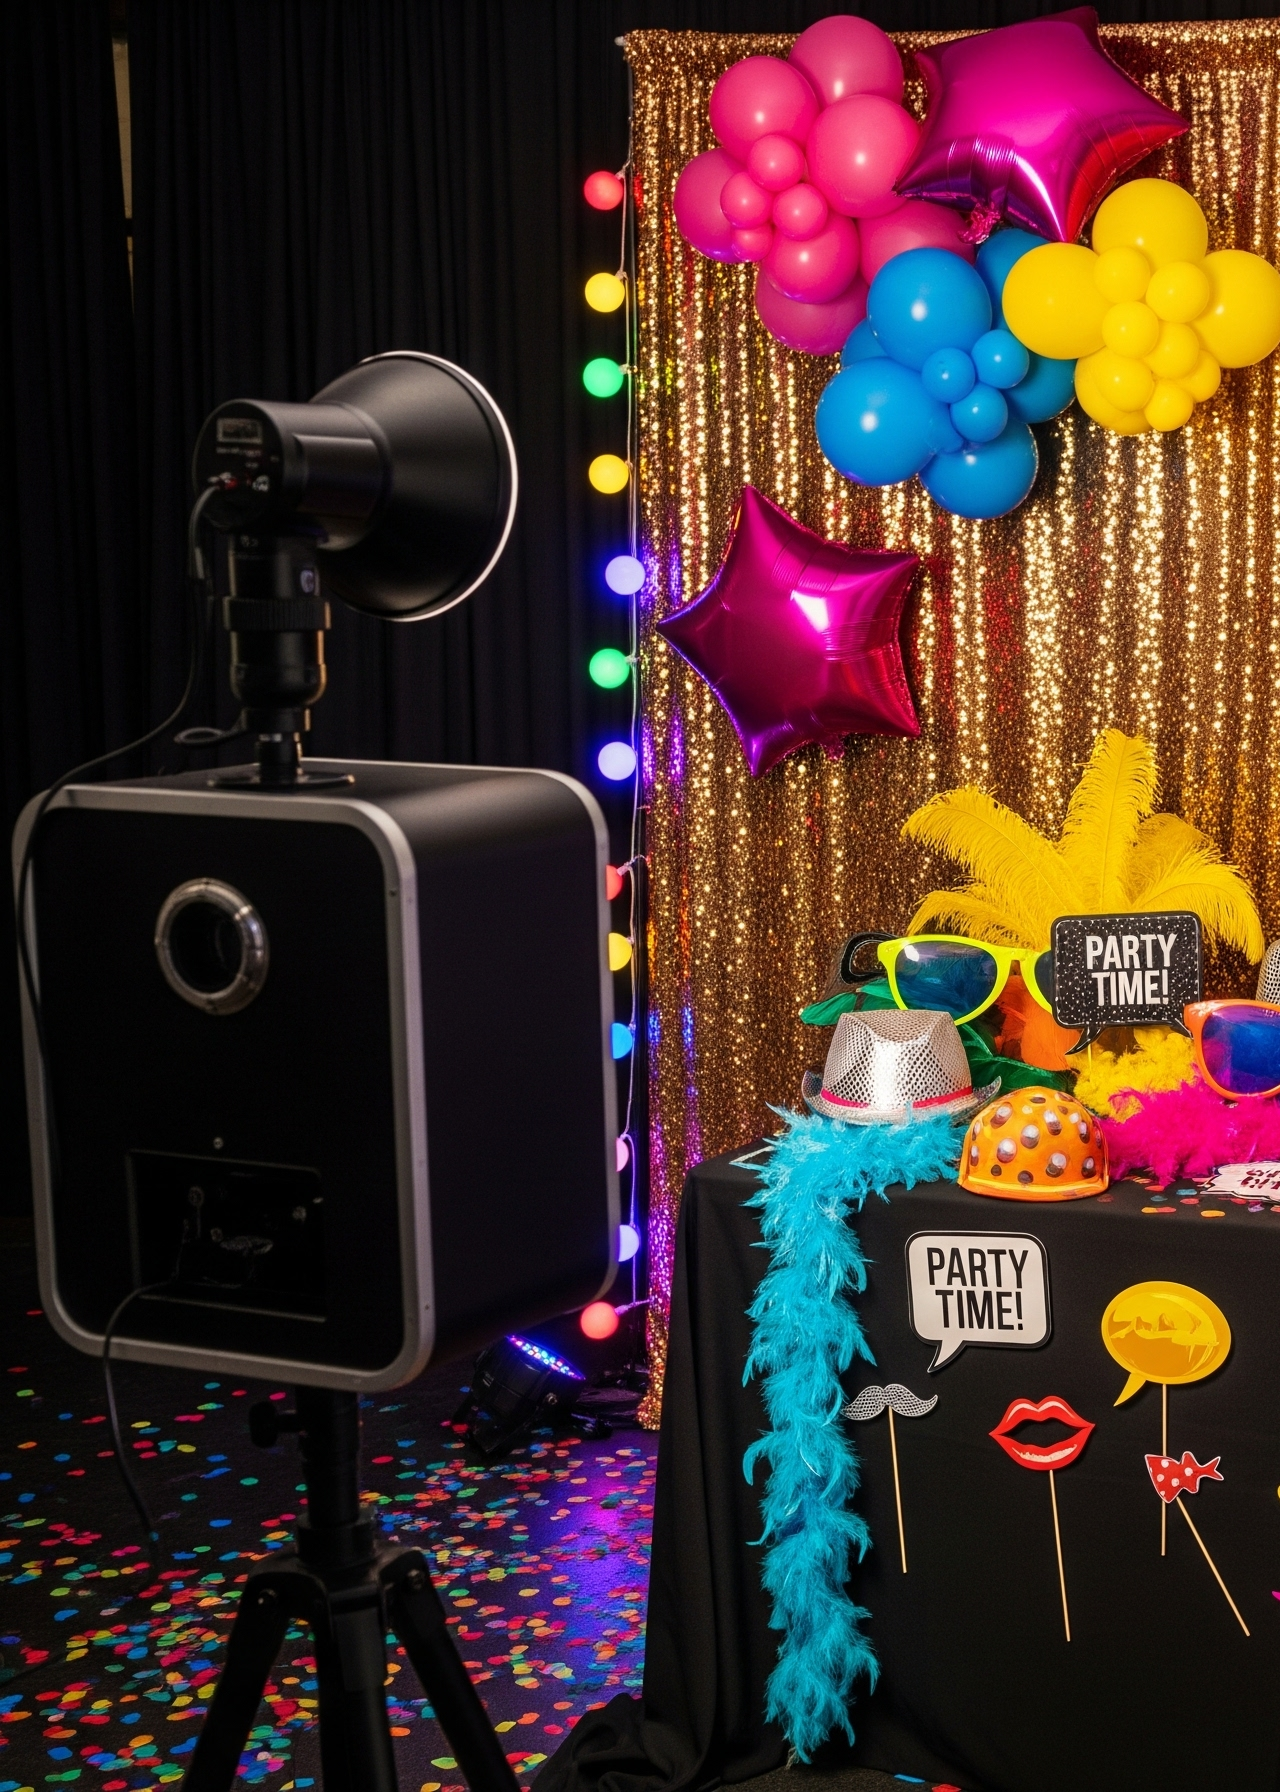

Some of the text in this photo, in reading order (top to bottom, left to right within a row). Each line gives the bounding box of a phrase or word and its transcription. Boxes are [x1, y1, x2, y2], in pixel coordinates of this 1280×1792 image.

[1086, 933, 1178, 970] PARTY
[1091, 969, 1169, 1006] TIME!
[926, 1247, 1029, 1289] PARTY
[935, 1289, 1024, 1331] TIME!
